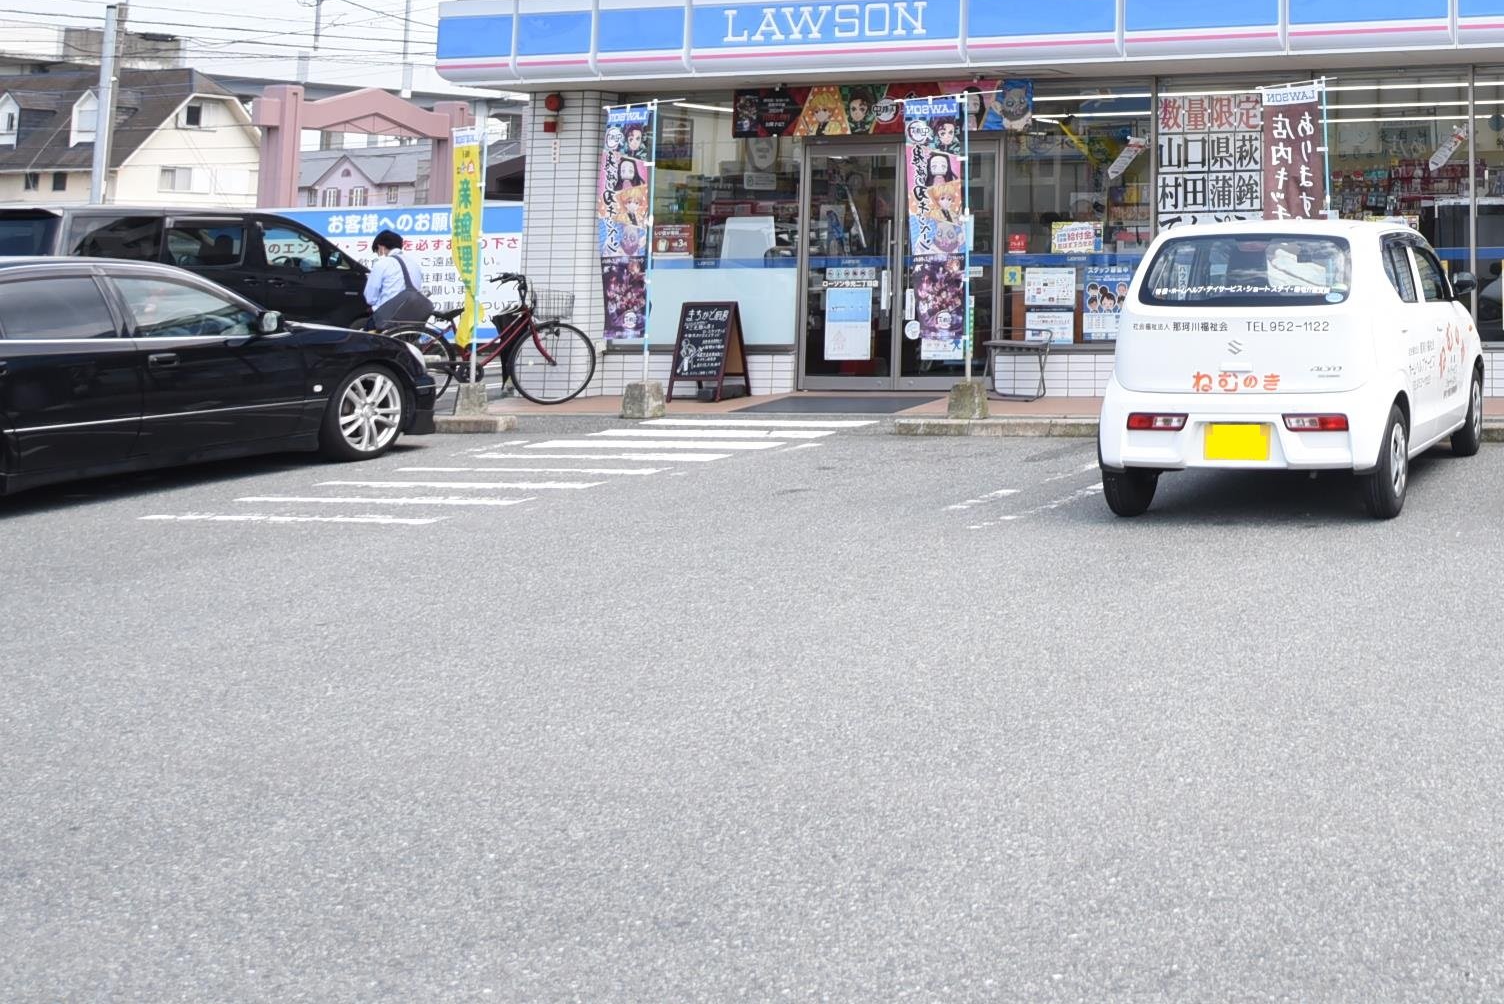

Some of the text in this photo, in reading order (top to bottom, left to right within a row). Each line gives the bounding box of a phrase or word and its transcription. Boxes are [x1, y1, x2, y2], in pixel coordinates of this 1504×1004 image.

[723, 1, 928, 43] LAWSON
[1160, 98, 1261, 130] 数量限定
[1159, 135, 1260, 168] 山口県萩
[1159, 174, 1260, 209] 村田蒲鉾
[1173, 321, 1228, 331] 那珂川福祉会
[1192, 371, 1280, 393] ねむのき
